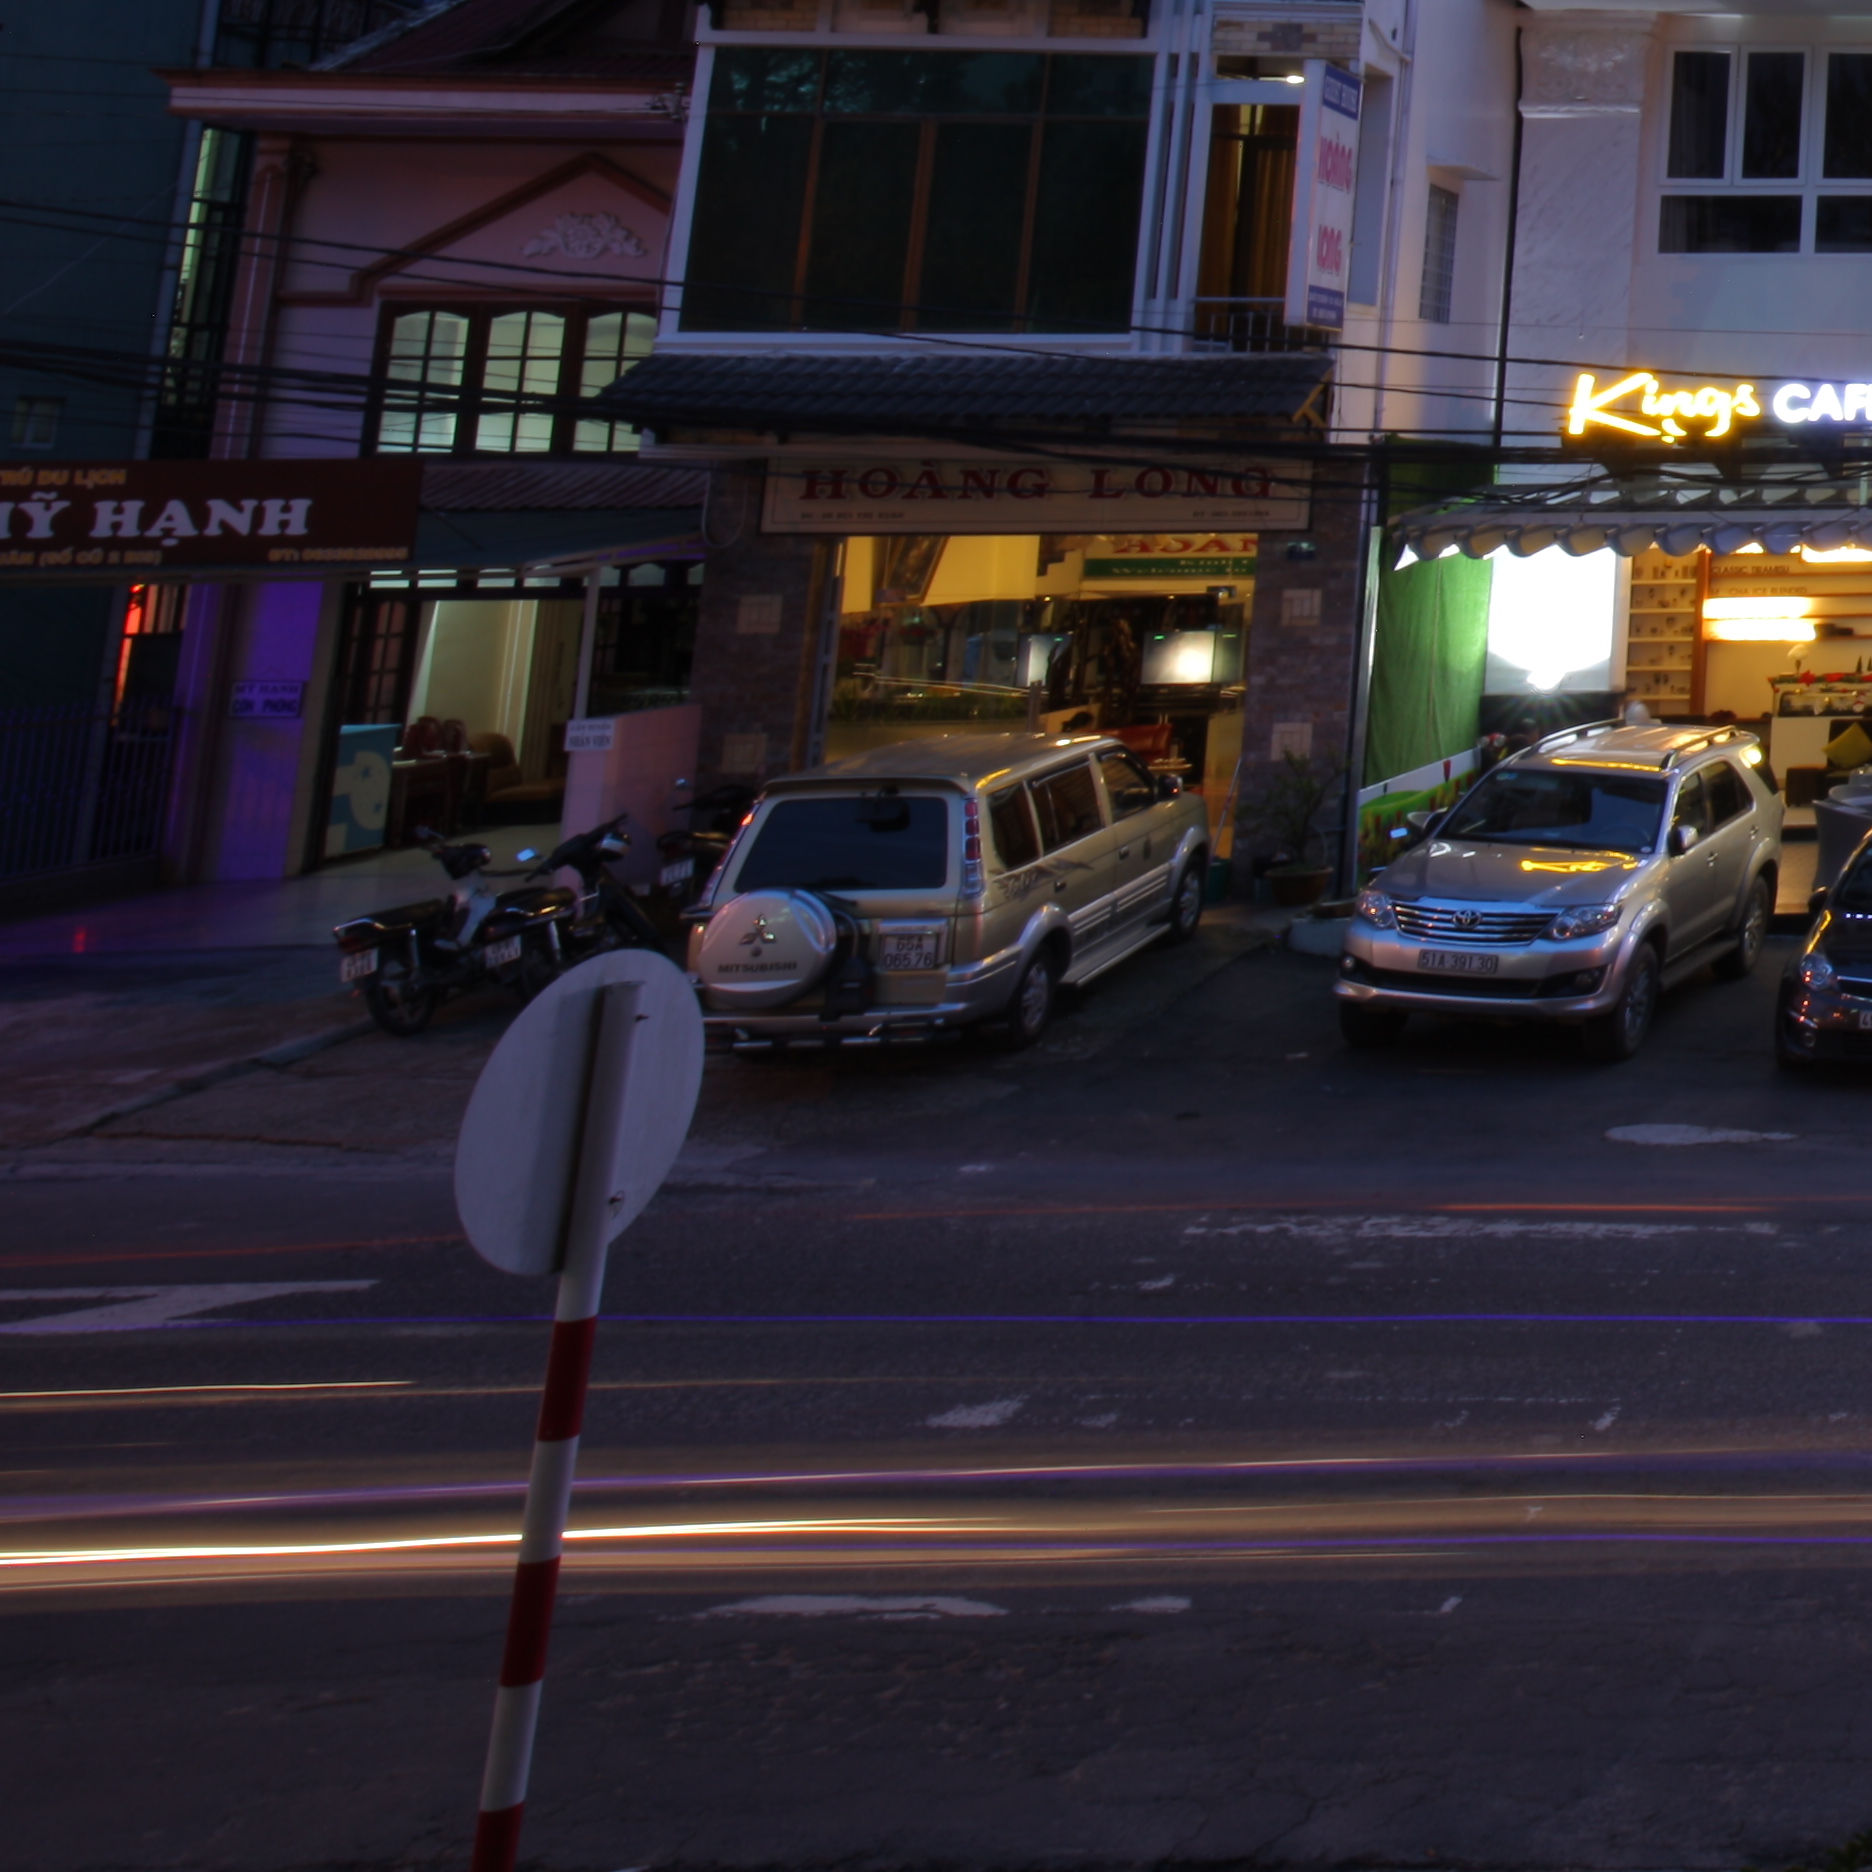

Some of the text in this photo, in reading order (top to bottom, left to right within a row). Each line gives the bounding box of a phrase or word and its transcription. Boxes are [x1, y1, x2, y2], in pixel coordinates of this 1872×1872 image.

[1567, 372, 1761, 444] Kings
[36, 468, 70, 486] DU
[73, 467, 128, 490] LỊCH
[800, 460, 1272, 500] HOÀNG LONG
[0, 490, 314, 547] Ỹ HẠNH
[718, 961, 798, 972] MITSUBISHI
